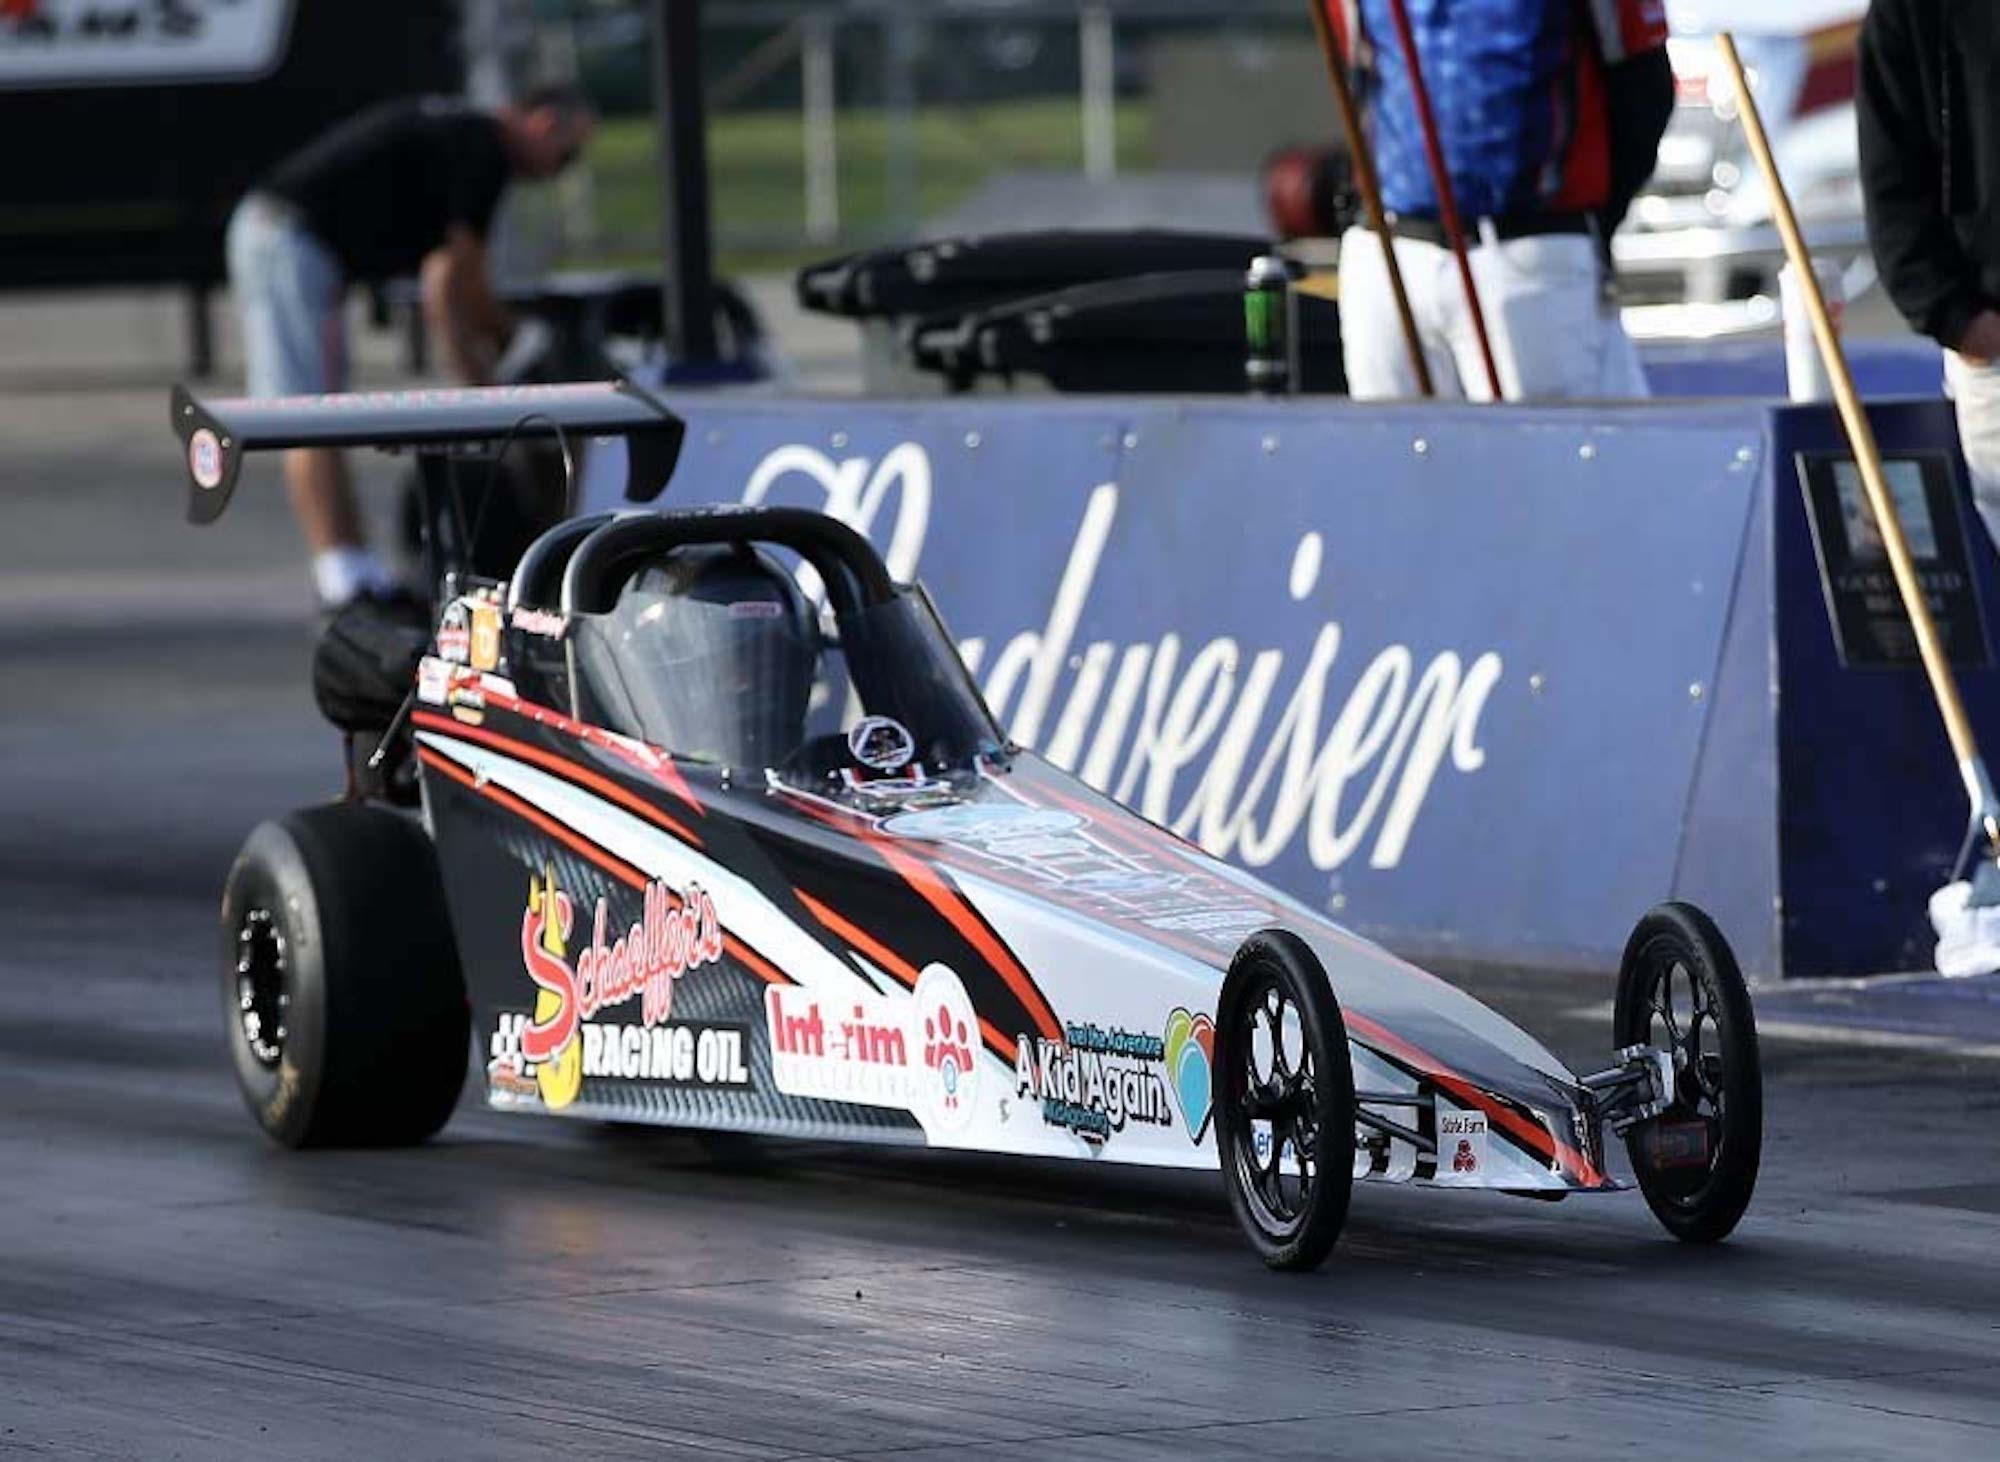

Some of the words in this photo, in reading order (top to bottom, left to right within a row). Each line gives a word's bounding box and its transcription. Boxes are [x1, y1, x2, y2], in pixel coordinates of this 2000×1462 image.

[581, 1022, 695, 1081] RACING
[696, 1027, 748, 1084] OIL
[1016, 1035, 1037, 1096] A
[1038, 1041, 1081, 1104] Kid
